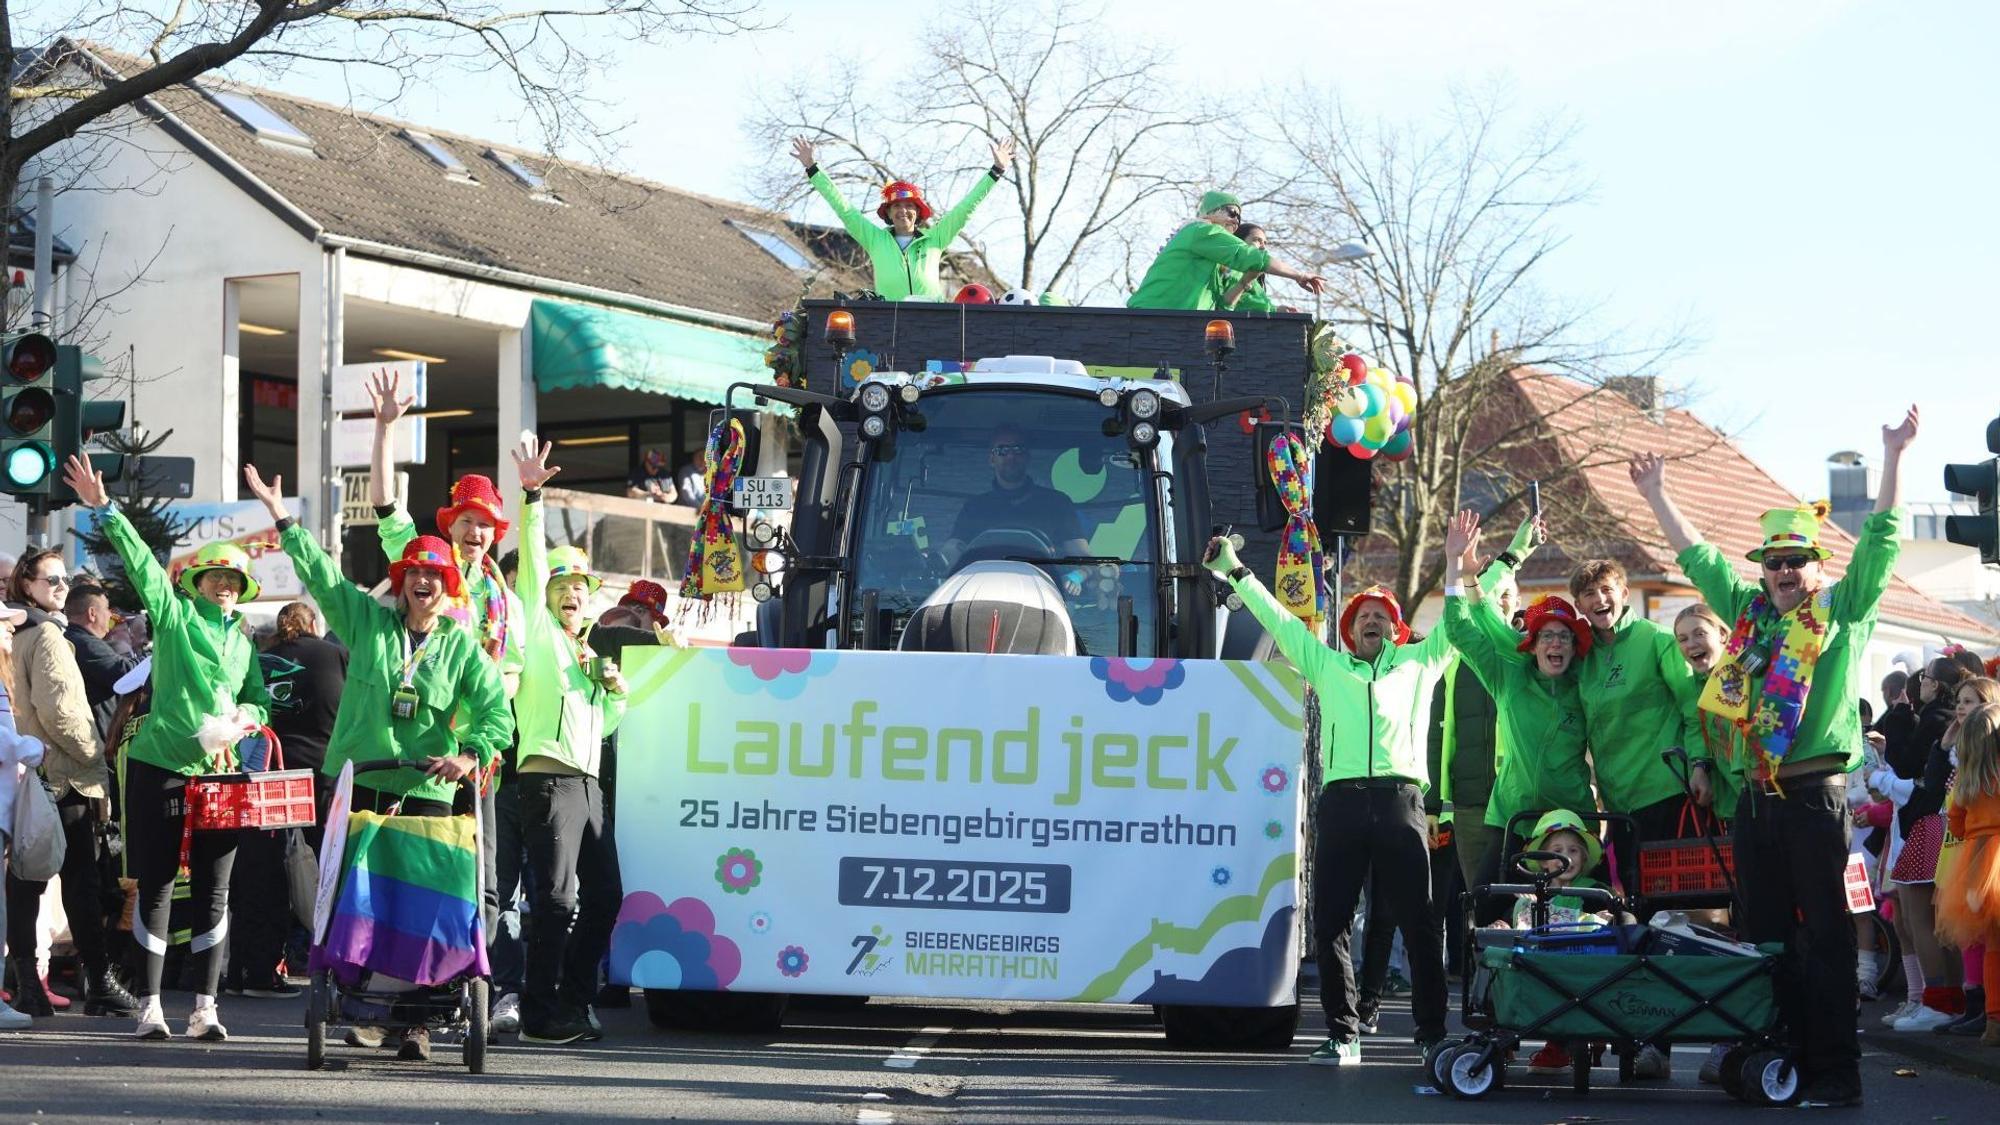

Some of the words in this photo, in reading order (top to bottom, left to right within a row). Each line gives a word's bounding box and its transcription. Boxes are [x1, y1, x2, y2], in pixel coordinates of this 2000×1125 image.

[747, 479, 766, 492] SU
[742, 494, 751, 506] H
[757, 494, 783, 507] 113
[687, 700, 1040, 785] Laufend
[1053, 712, 1240, 806] jeck
[680, 799, 720, 828] 25
[726, 799, 817, 831] Jahre
[826, 804, 1236, 847] Siebengebirgsmarathon
[862, 865, 1047, 905] 7.12.2025
[905, 931, 1060, 953] SIEBENGEBIRGS
[905, 952, 1059, 980] MARATHON
